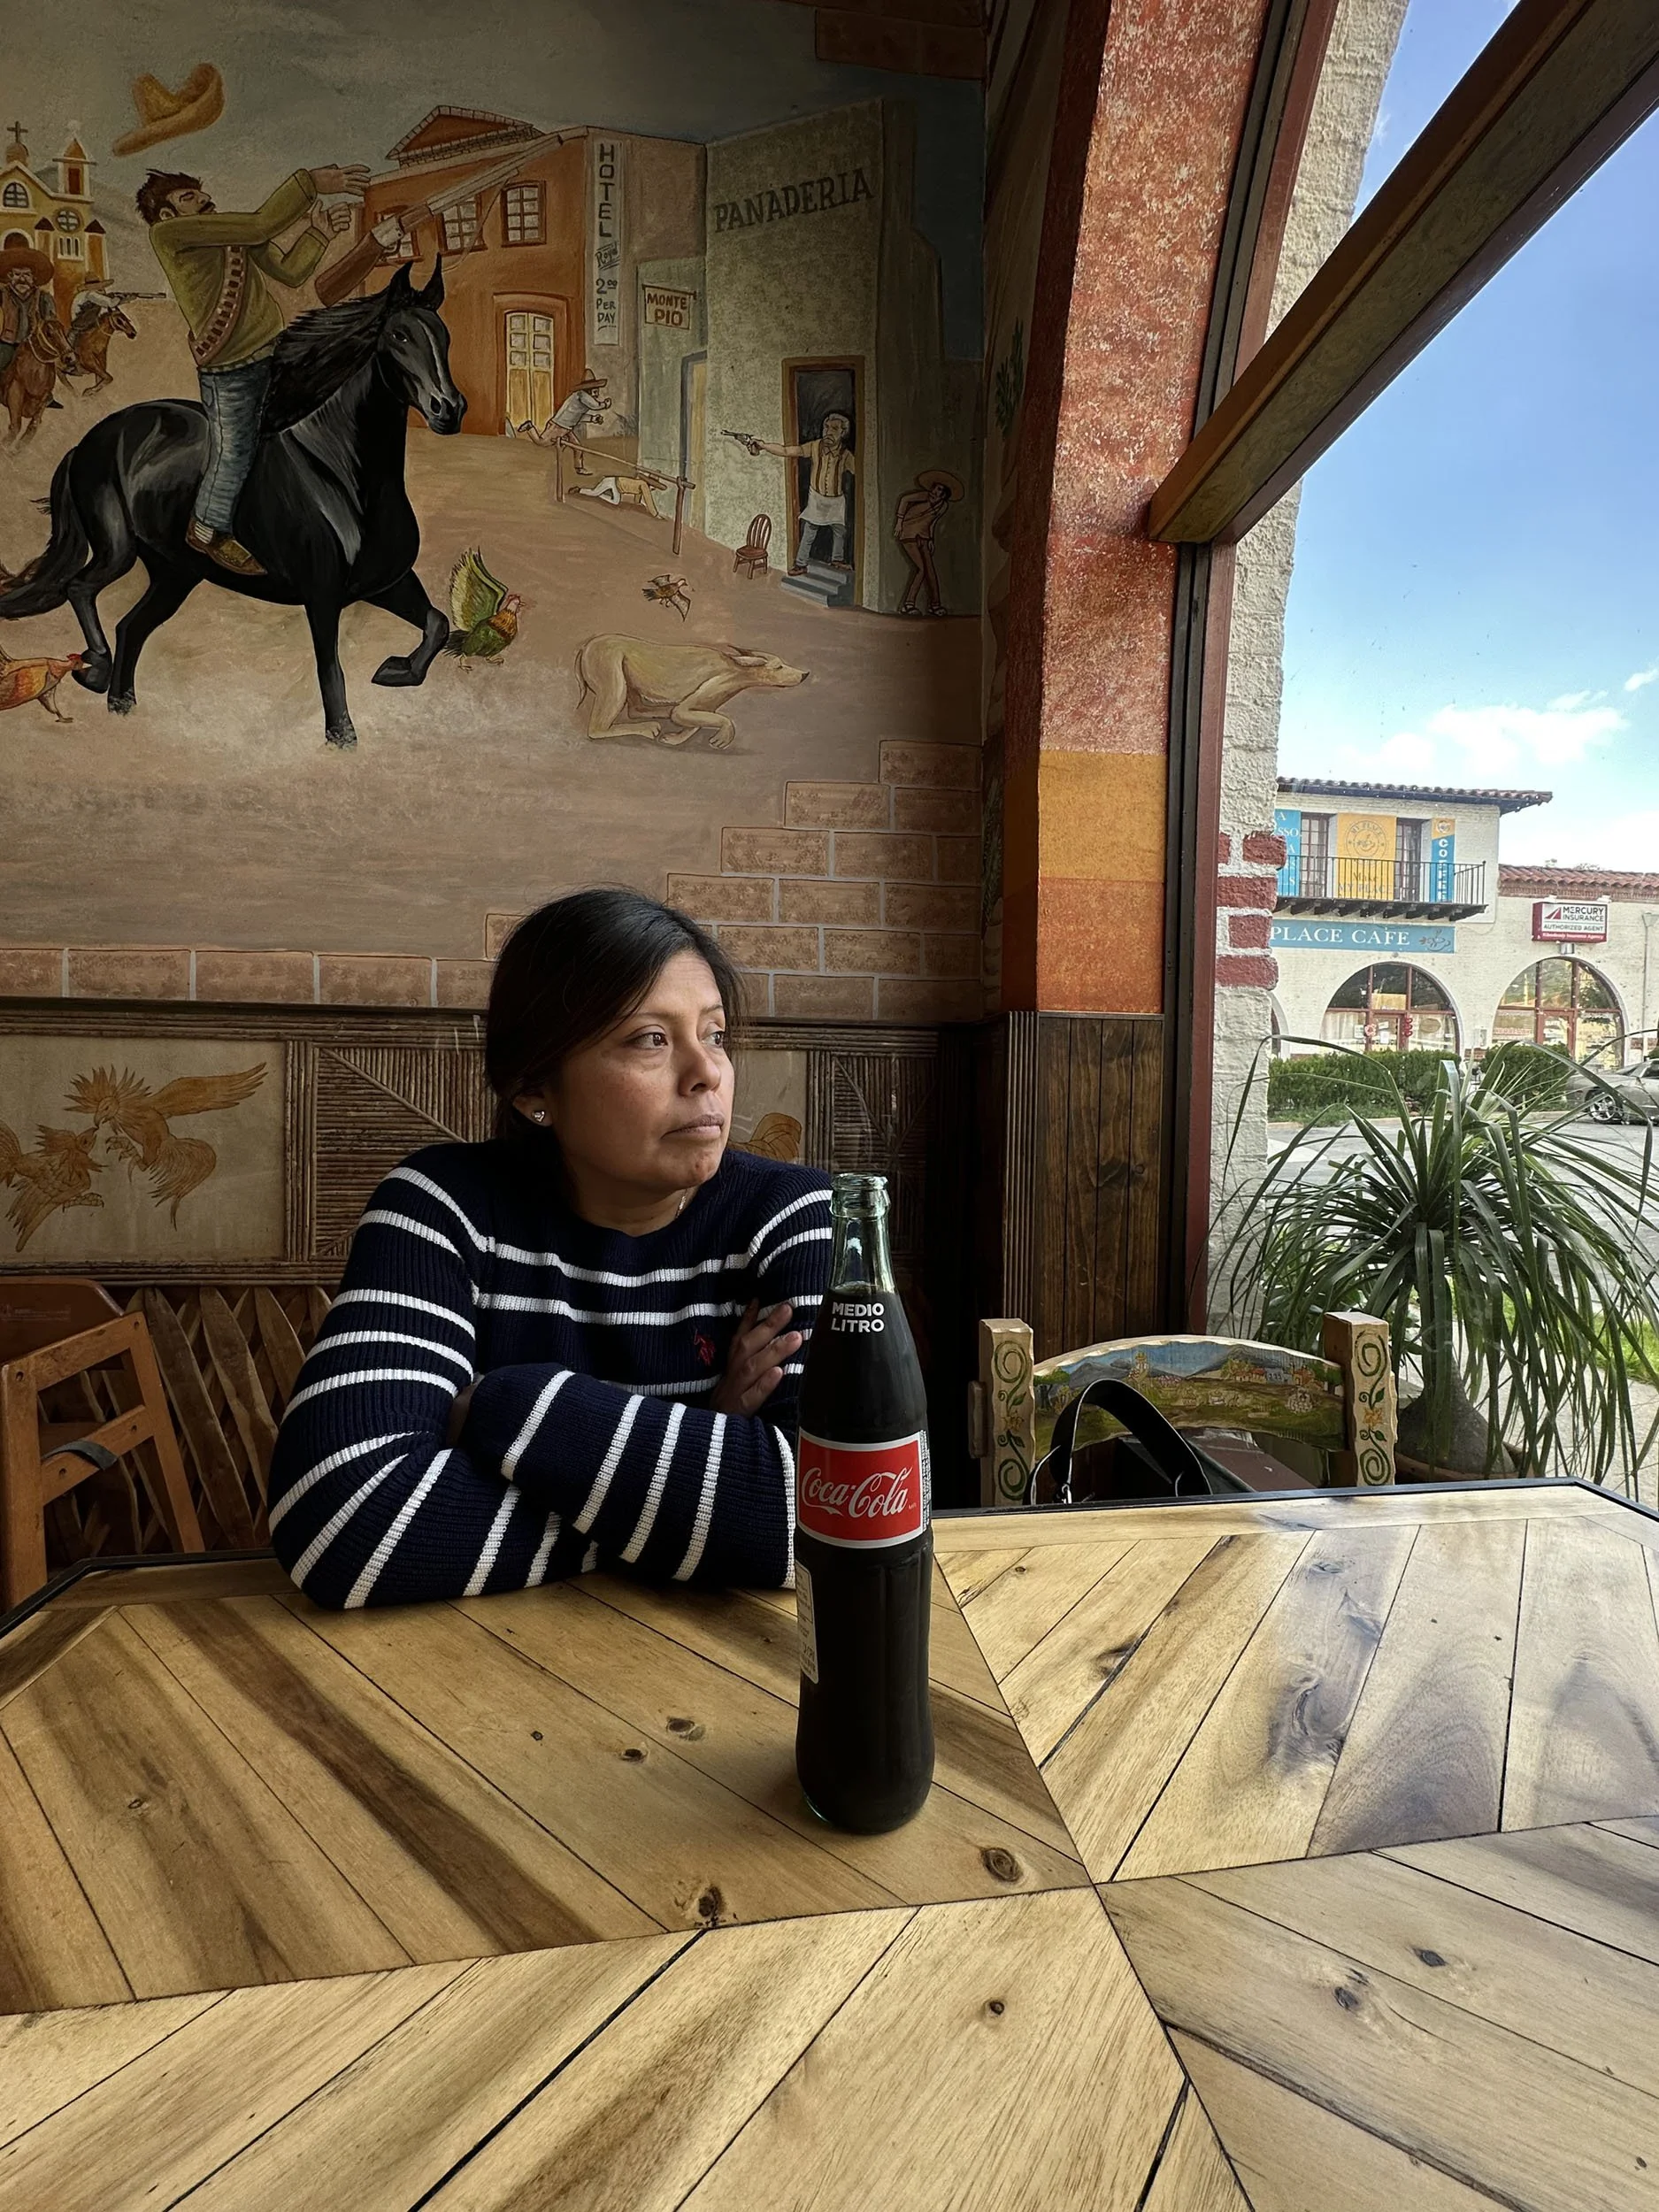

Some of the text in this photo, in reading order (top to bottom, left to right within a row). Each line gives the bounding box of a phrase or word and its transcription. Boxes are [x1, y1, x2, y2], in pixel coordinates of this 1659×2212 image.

[598, 143, 615, 237] HOTEL
[713, 167, 875, 233] PANADERIA
[596, 298, 616, 310] PER
[647, 293, 687, 310] MONTE
[597, 312, 616, 324] DAY
[655, 310, 683, 326] PIO
[1563, 906, 1604, 915] MERCURY
[1271, 926, 1410, 946] PLACE CAFE
[832, 1302, 885, 1317] MEDIO
[831, 1317, 885, 1333] LITRO
[802, 1466, 913, 1518] Coca-Cola
